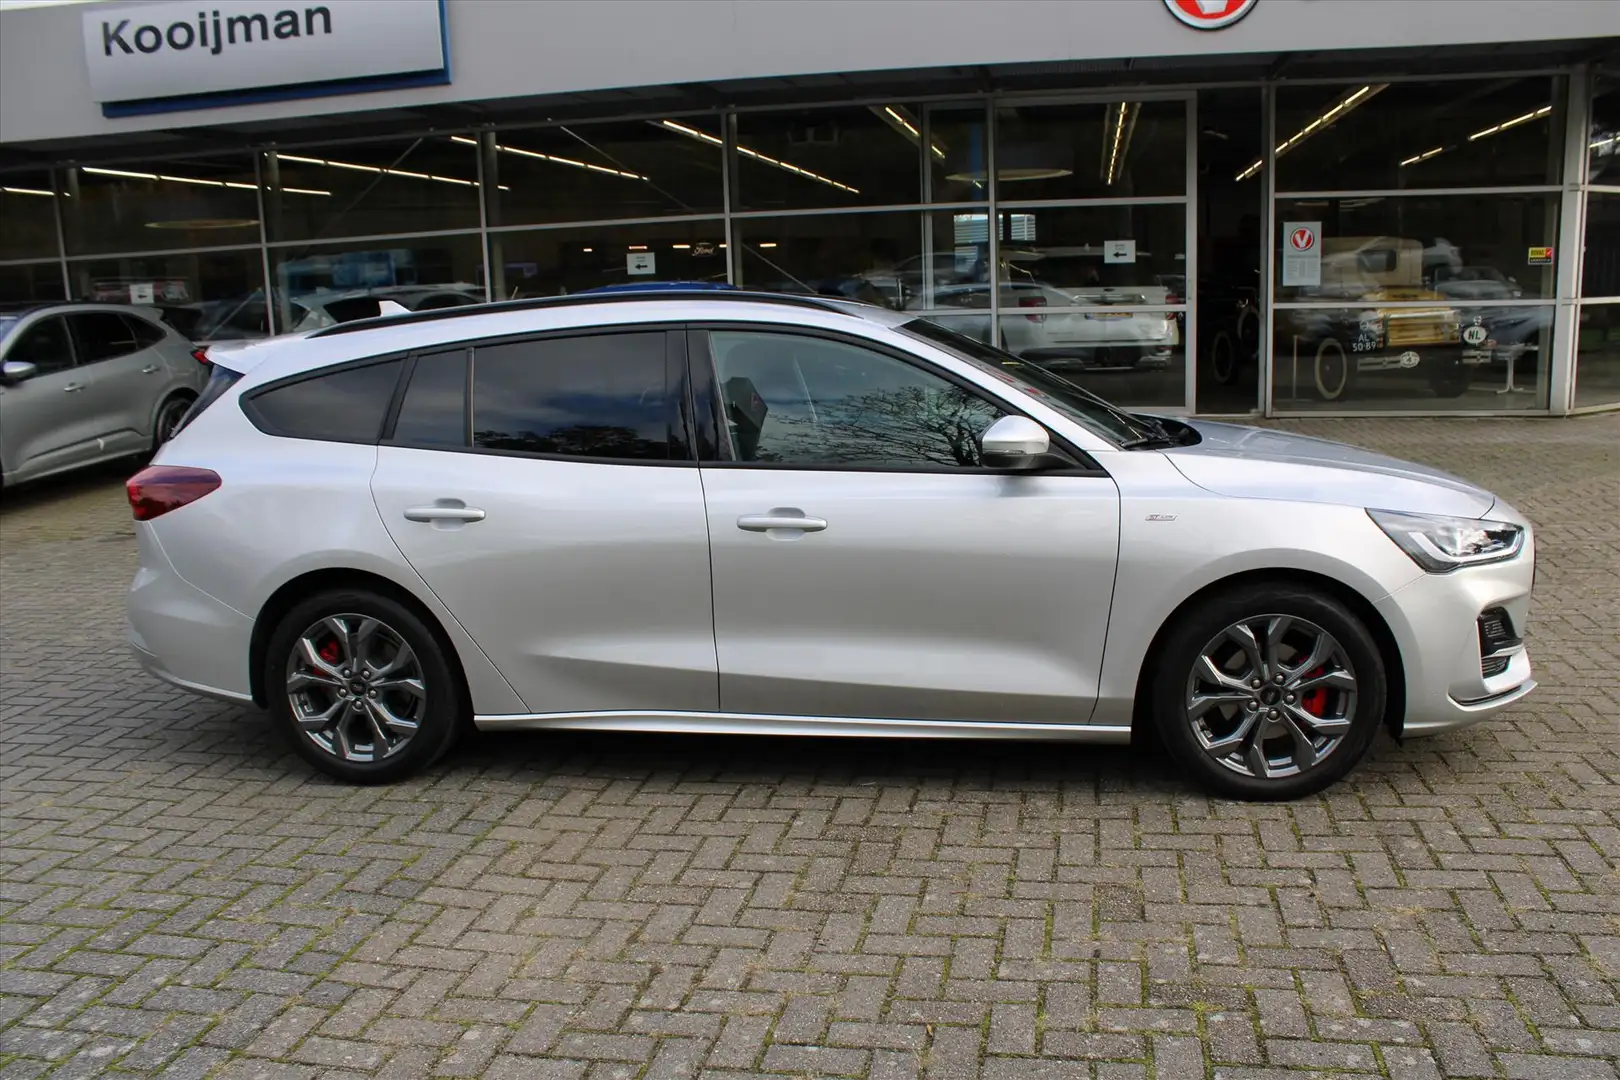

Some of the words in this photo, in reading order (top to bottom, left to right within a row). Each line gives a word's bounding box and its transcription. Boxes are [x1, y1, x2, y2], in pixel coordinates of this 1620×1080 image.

[102, 6, 332, 56] Kooijman
[1358, 334, 1370, 342] AL
[1467, 330, 1480, 340] NL
